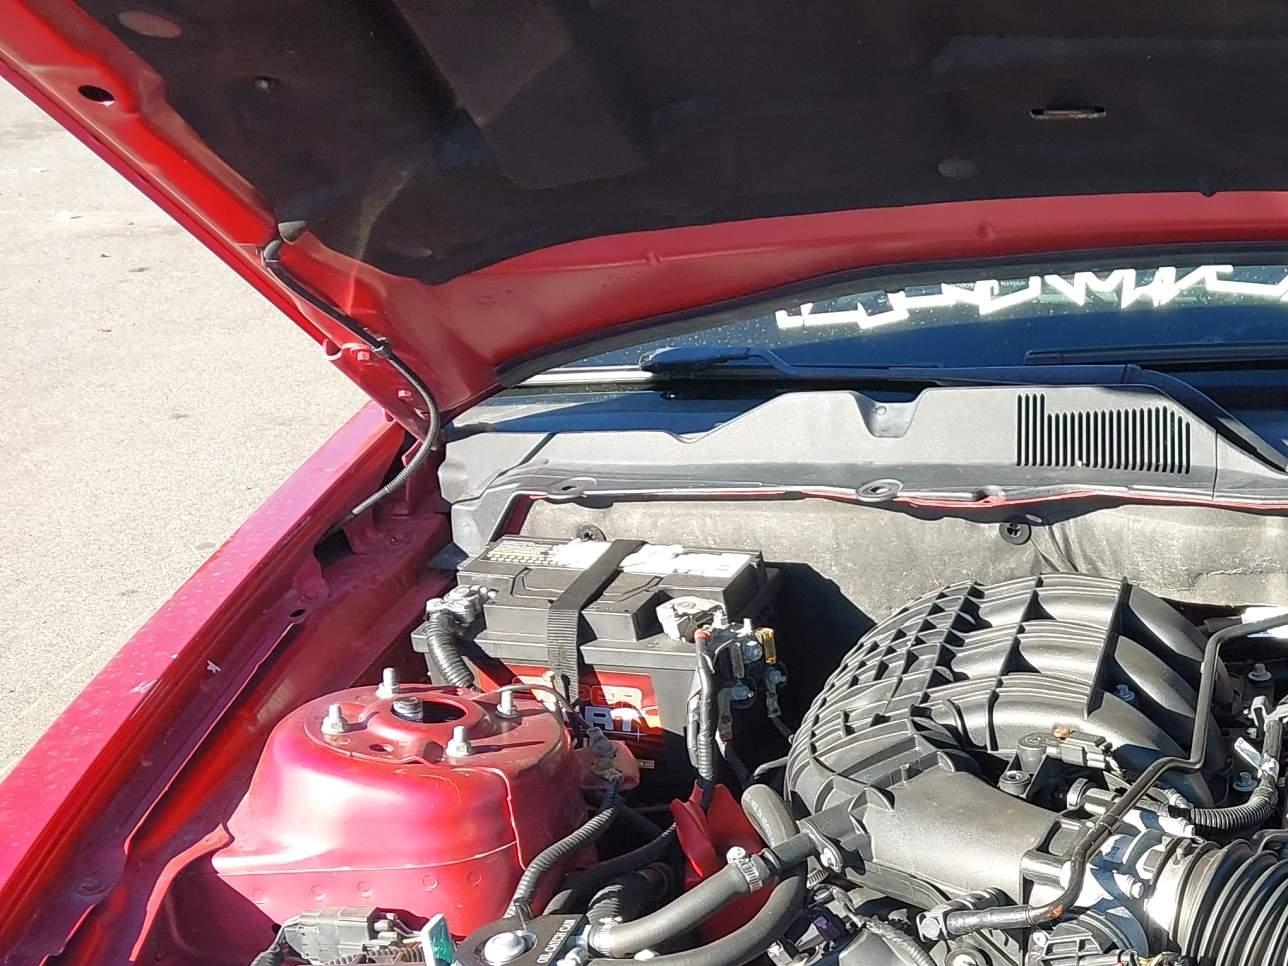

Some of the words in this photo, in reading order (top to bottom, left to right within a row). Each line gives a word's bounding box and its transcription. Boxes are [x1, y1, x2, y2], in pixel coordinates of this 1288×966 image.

[558, 919, 577, 932] CAN
[544, 932, 567, 952] CATCH
[536, 952, 553, 964] OIL
